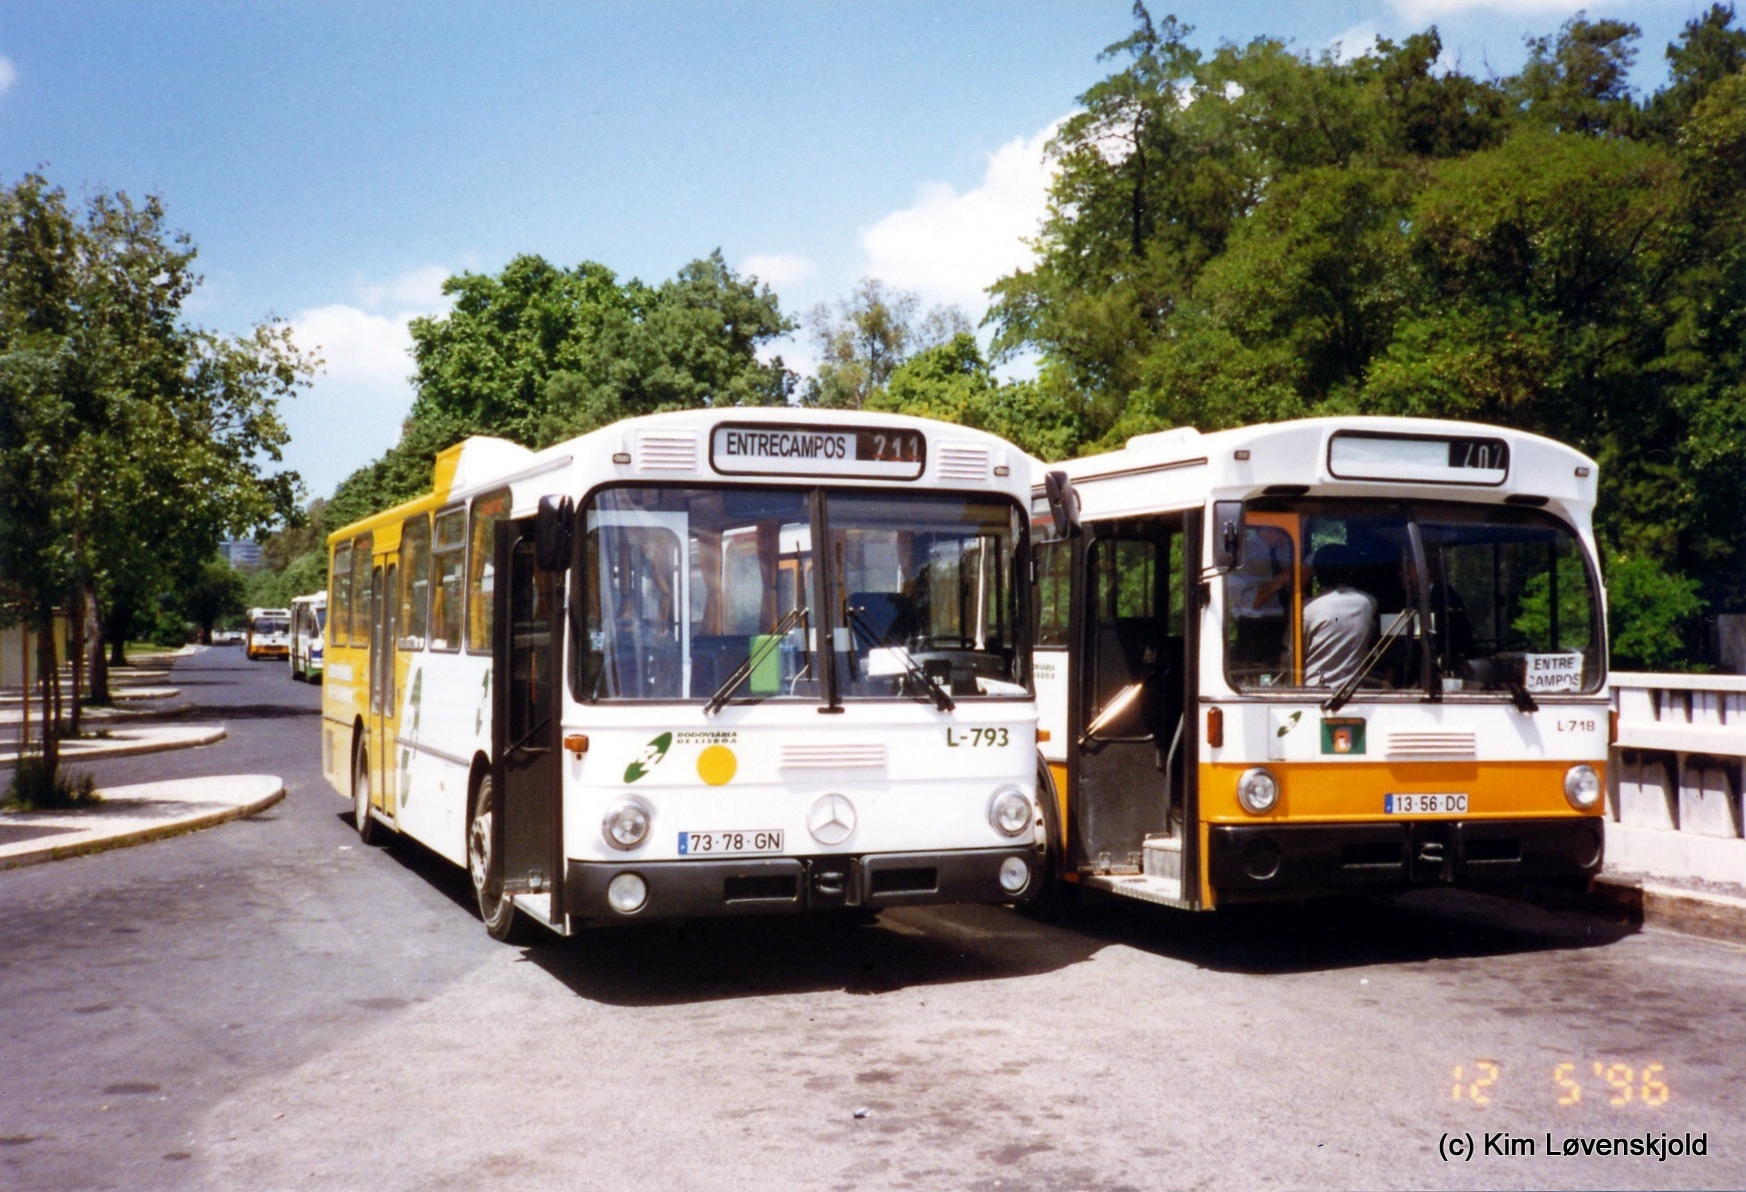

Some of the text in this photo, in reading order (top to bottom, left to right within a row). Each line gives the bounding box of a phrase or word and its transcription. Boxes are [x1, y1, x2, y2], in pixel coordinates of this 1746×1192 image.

[726, 431, 920, 462] ENTRECAMPOS 211
[1534, 657, 1575, 671] ENTRE
[1528, 673, 1581, 688] CAMPOS
[946, 727, 1009, 748] L-793
